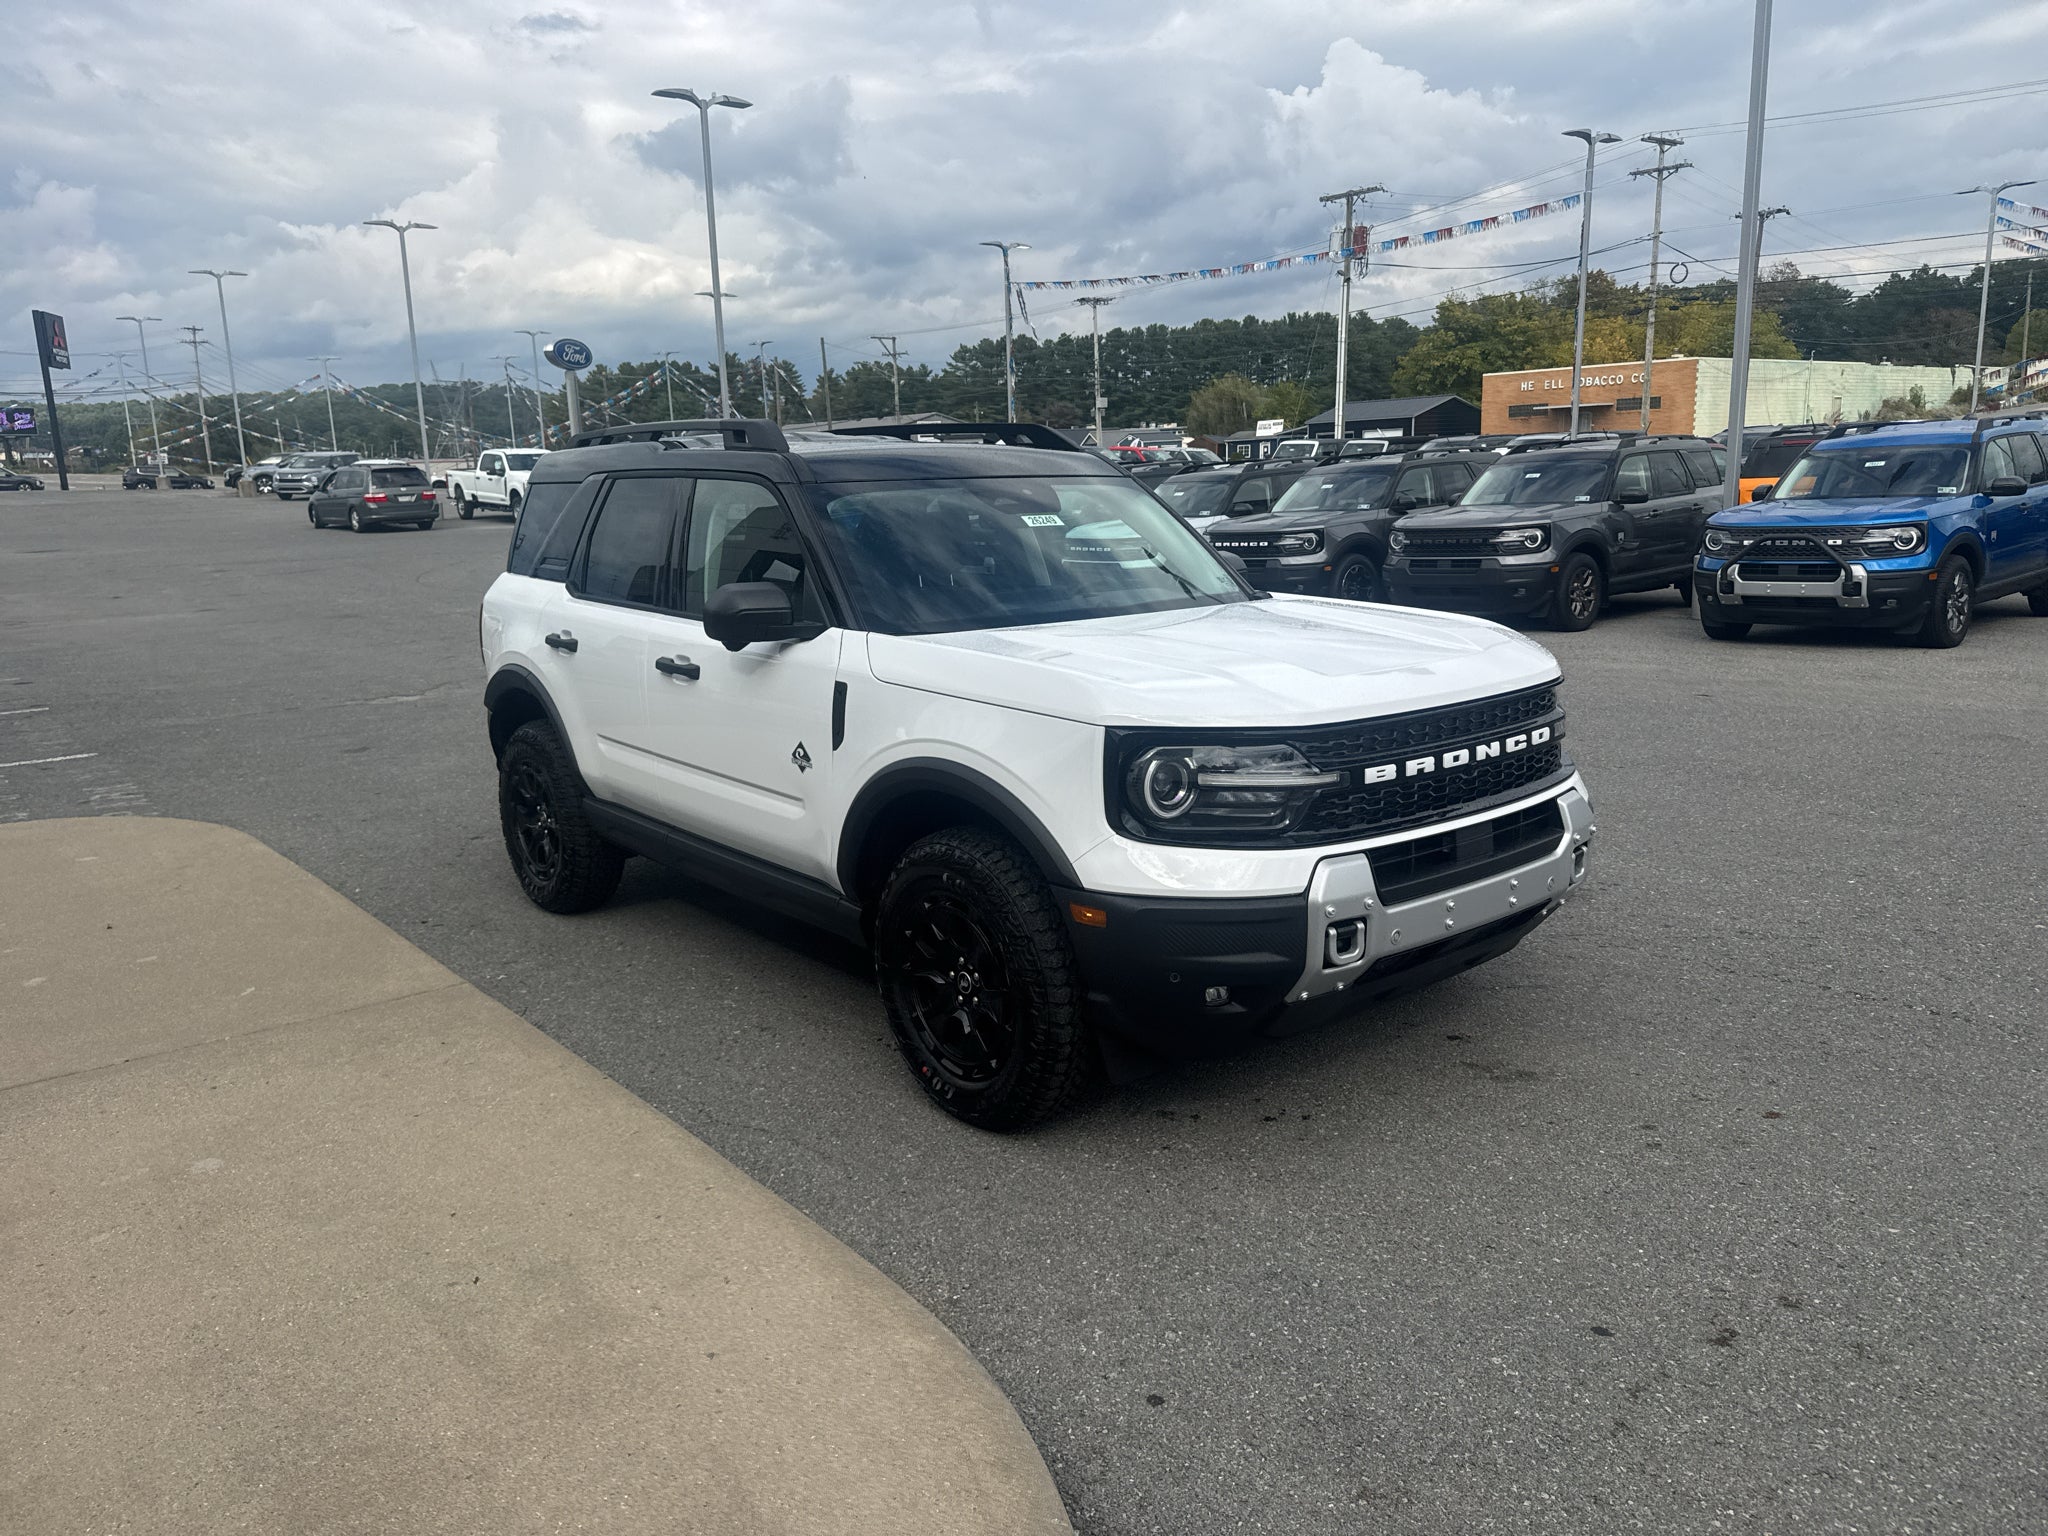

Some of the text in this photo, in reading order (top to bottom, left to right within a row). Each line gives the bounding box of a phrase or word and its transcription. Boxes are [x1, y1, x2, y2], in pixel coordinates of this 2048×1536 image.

[562, 344, 586, 364] Ford
[1579, 374, 1624, 387] OBACCO
[1027, 515, 1058, 525] 26249
[1364, 726, 1550, 784] BRONCO
